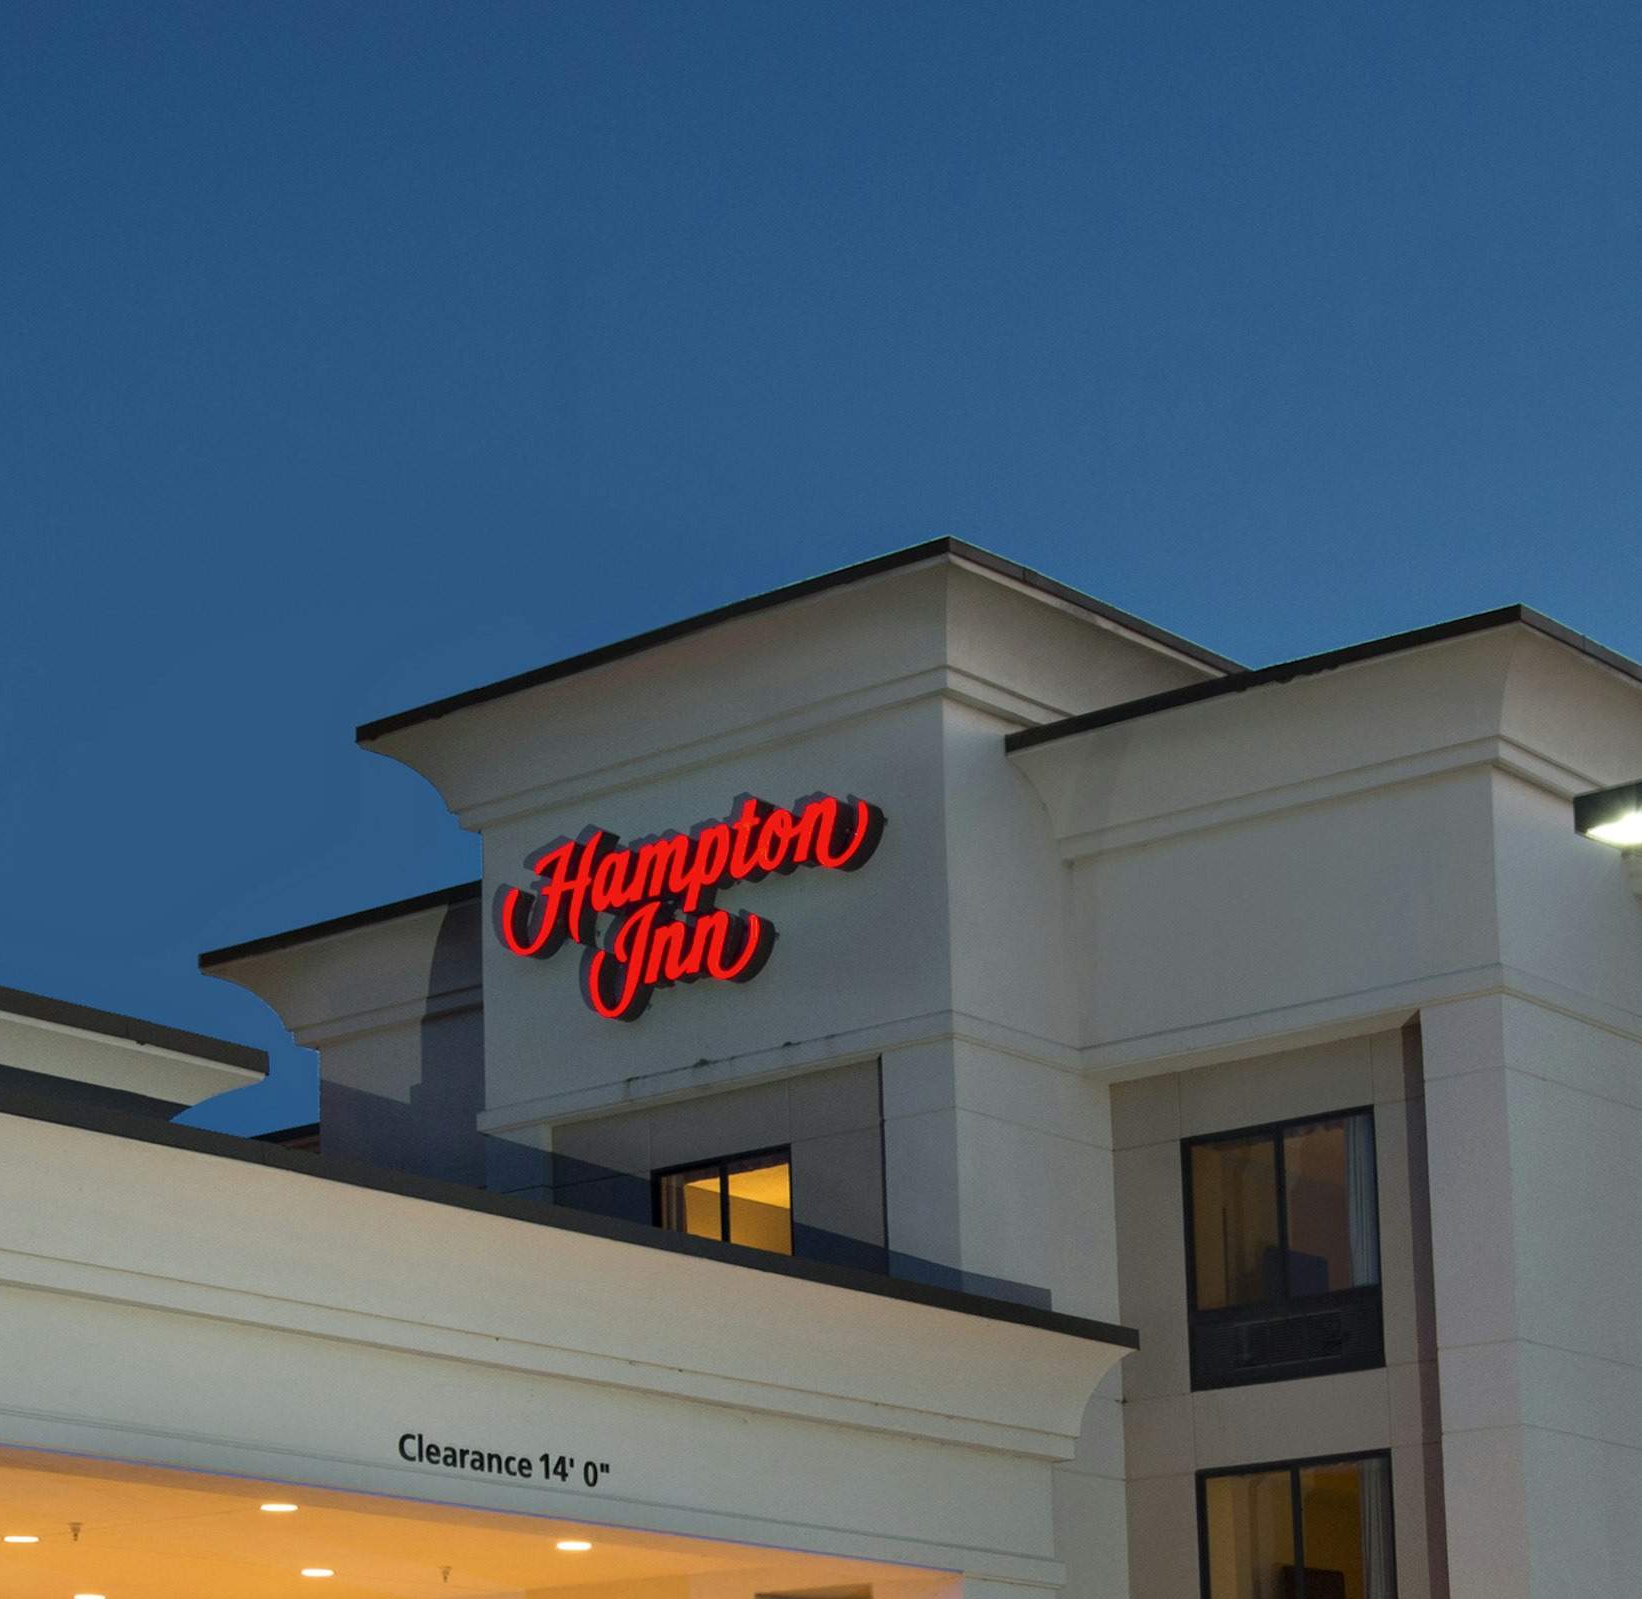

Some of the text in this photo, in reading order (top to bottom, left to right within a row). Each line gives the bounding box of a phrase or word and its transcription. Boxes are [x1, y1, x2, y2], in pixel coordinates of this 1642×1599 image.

[501, 796, 871, 957] Hampton
[588, 901, 762, 1019] Inn
[397, 1432, 533, 1479] Clearance
[538, 1452, 575, 1483] 14'
